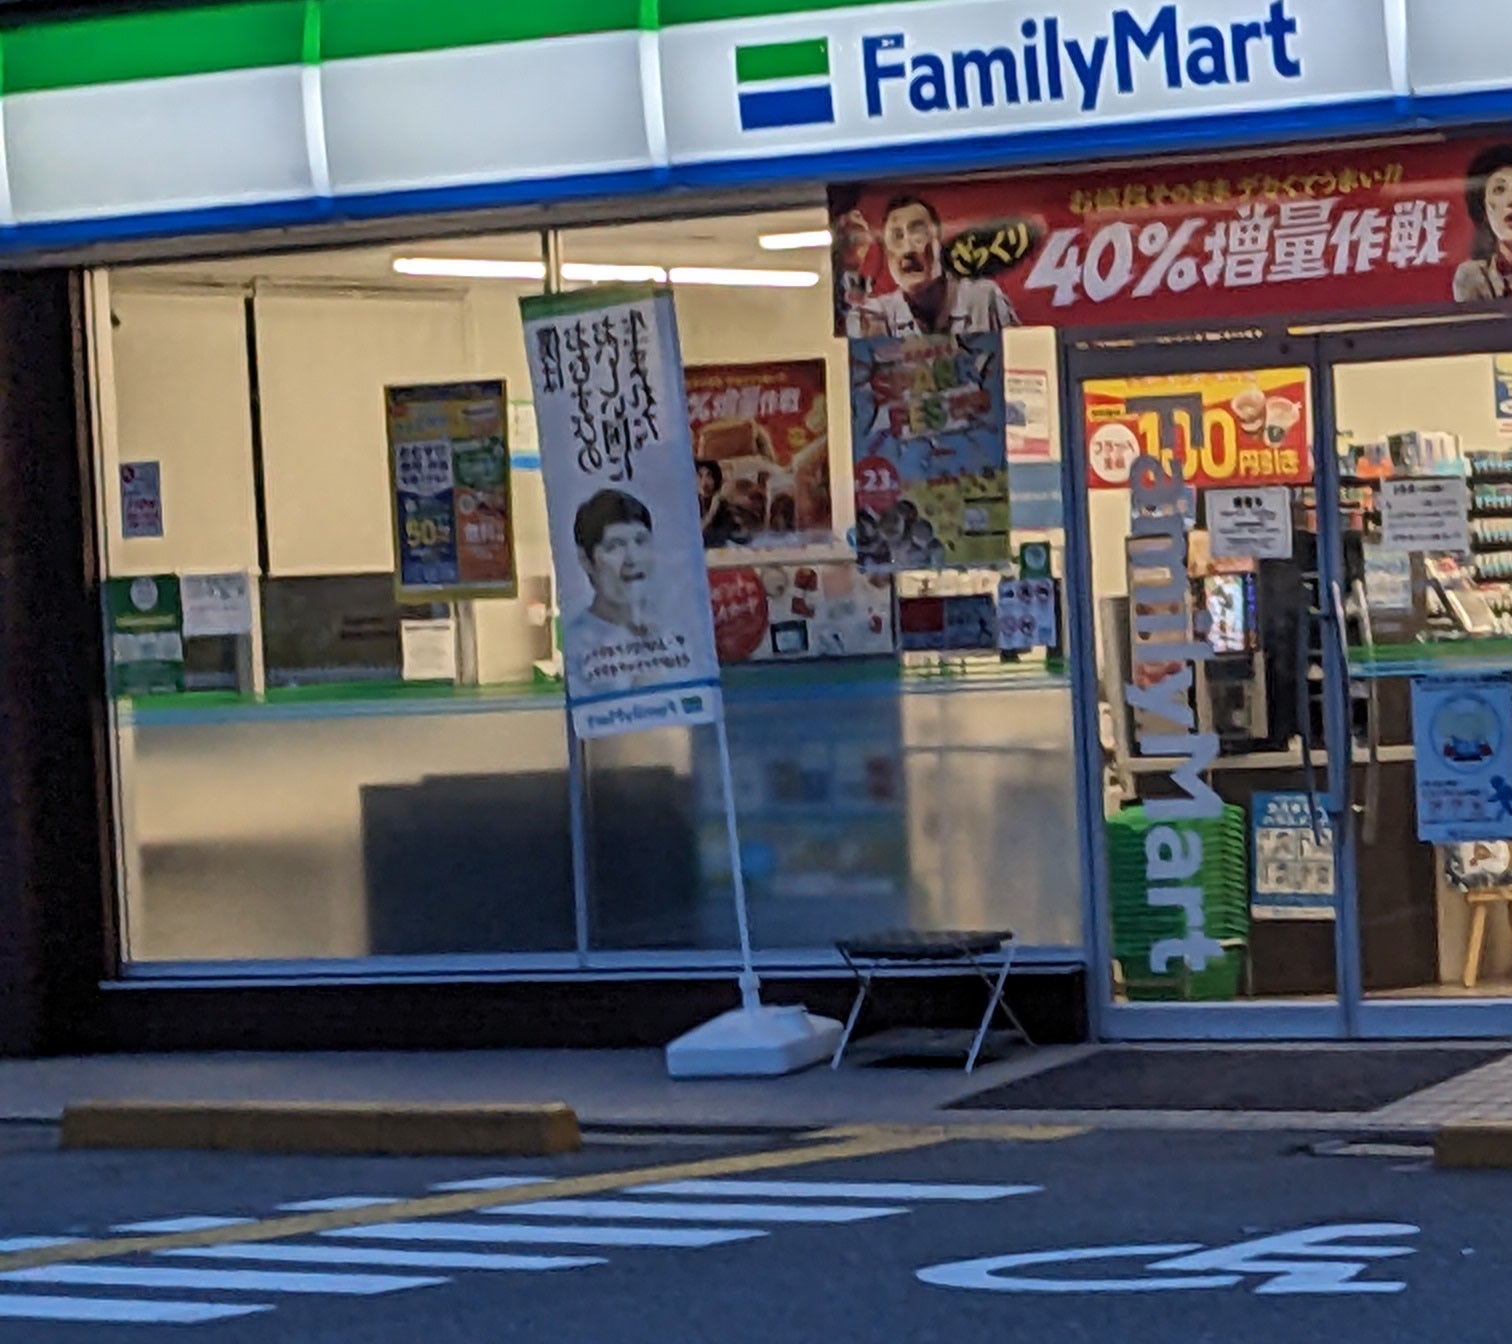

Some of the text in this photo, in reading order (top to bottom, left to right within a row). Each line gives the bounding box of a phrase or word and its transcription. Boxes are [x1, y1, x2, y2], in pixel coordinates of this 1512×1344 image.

[1024, 197, 1451, 308] 40%増量作戦
[1125, 392, 1225, 973] FamilyMart
